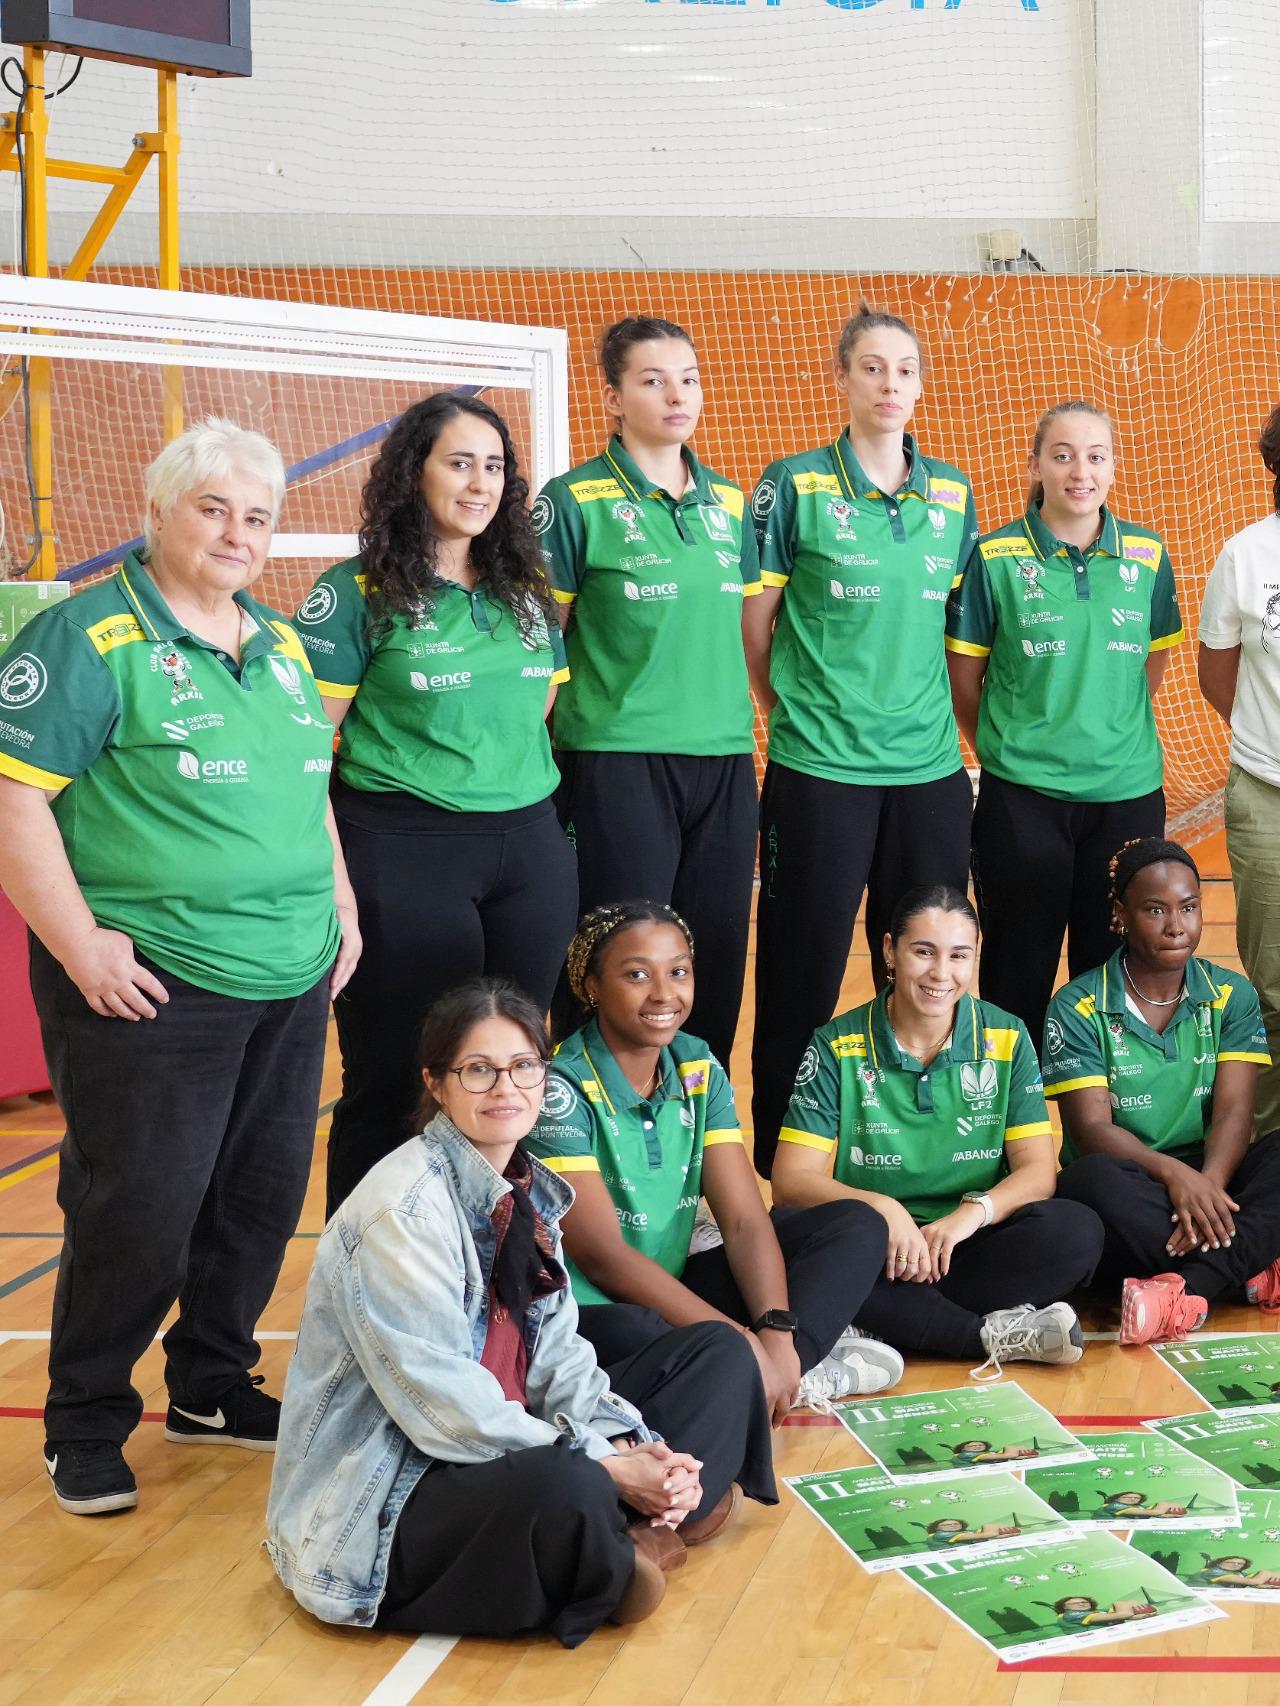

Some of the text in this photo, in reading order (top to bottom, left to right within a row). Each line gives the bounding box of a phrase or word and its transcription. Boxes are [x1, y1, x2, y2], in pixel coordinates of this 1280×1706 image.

[635, 553, 658, 562] XUNTA
[636, 560, 645, 568] DE
[843, 553, 865, 561] XUNTA
[641, 582, 678, 597] ence
[846, 584, 881, 597] ence
[1035, 639, 1066, 652] ence
[430, 671, 471, 687] ence
[170, 691, 204, 706] ARXIL
[187, 714, 225, 725] DEPORTE
[189, 720, 224, 731] GALEGO
[202, 760, 248, 776] ence
[768, 823, 778, 898] ARXIL
[971, 1101, 992, 1111] LF2
[1120, 1093, 1152, 1107] ence
[865, 1153, 902, 1166] ence
[616, 1208, 648, 1226] ence
[1167, 1348, 1211, 1363] II
[847, 1406, 892, 1424] II
[1167, 1423, 1217, 1441] II
[803, 1480, 857, 1501] II
